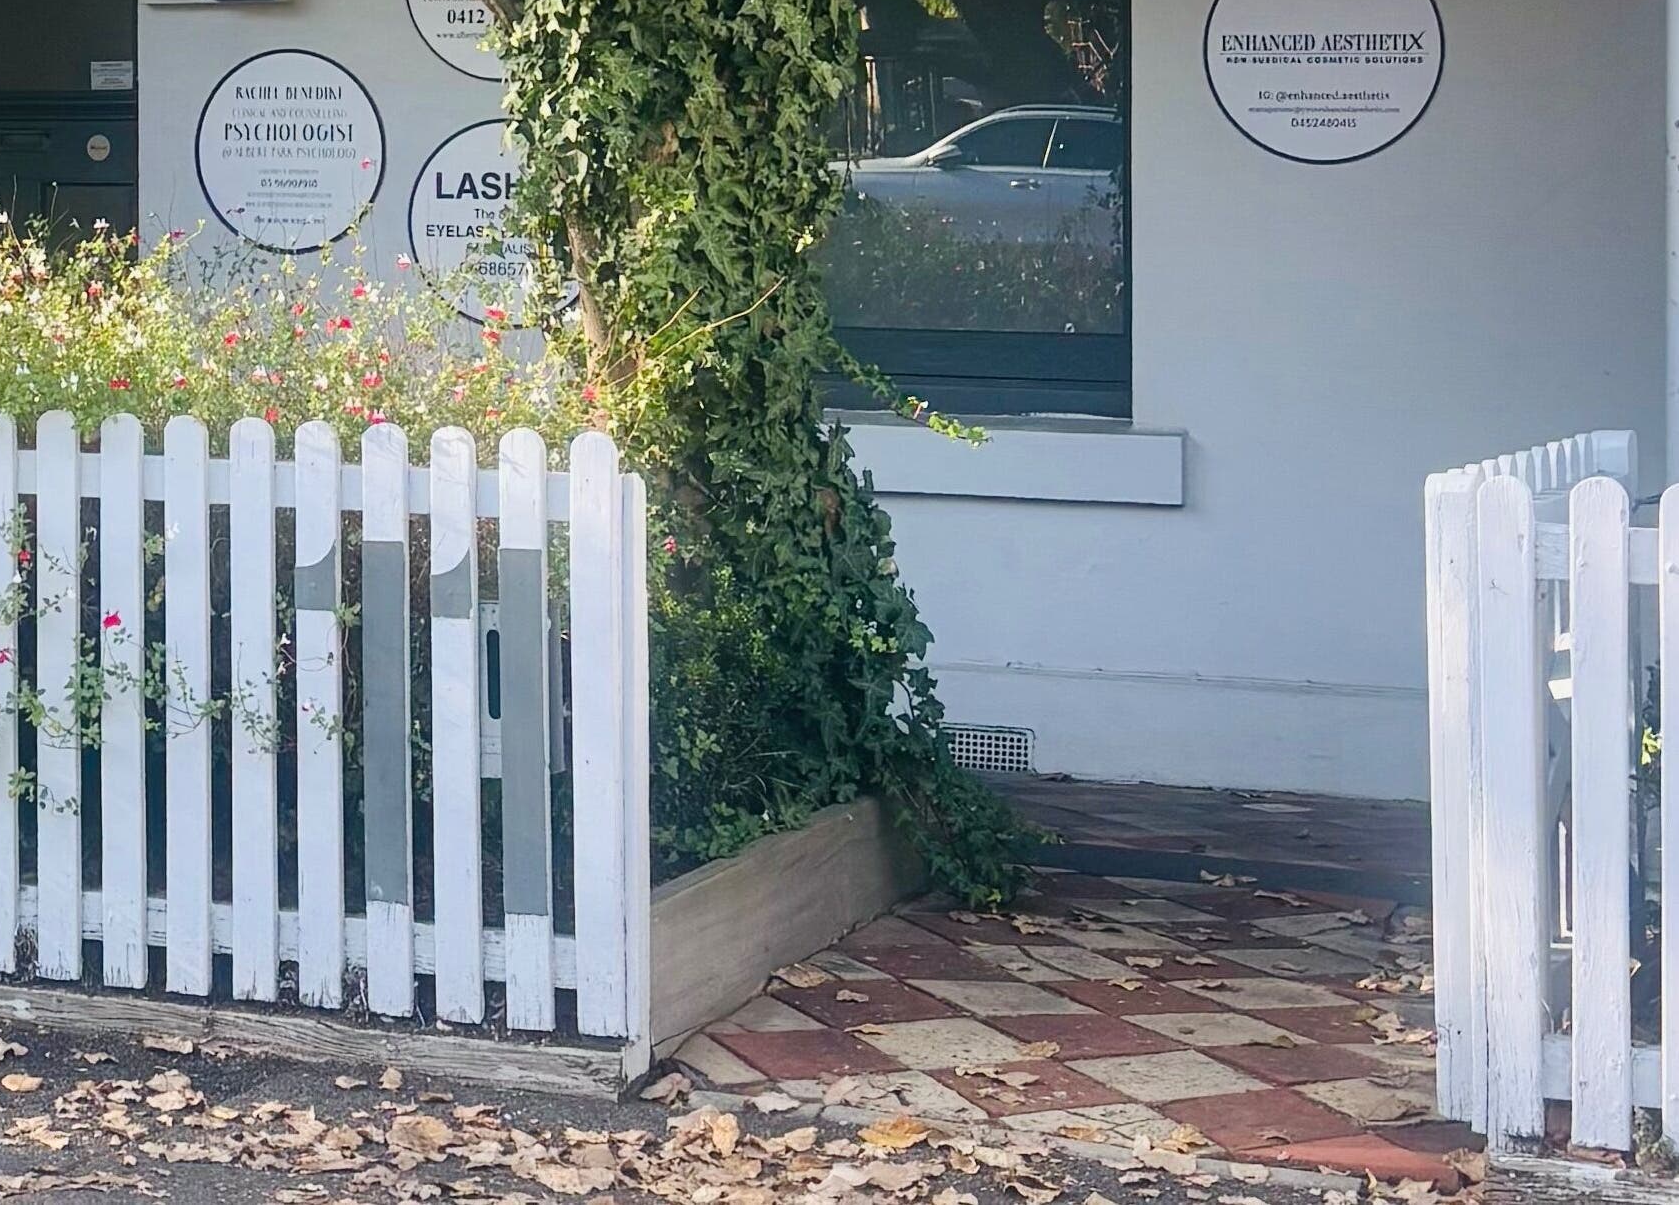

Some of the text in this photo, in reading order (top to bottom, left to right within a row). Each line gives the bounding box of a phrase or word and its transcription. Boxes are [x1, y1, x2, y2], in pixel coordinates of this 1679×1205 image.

[447, 8, 486, 24] 0412
[1221, 30, 1427, 52] ENHANCED AESTHETIX
[1307, 56, 1361, 64] COSMETIC
[1365, 56, 1424, 64] SOLUTIONS
[235, 85, 279, 100] RACHEL
[224, 122, 354, 142] PSYCHOLOGIST
[426, 224, 490, 238] EYELAS
